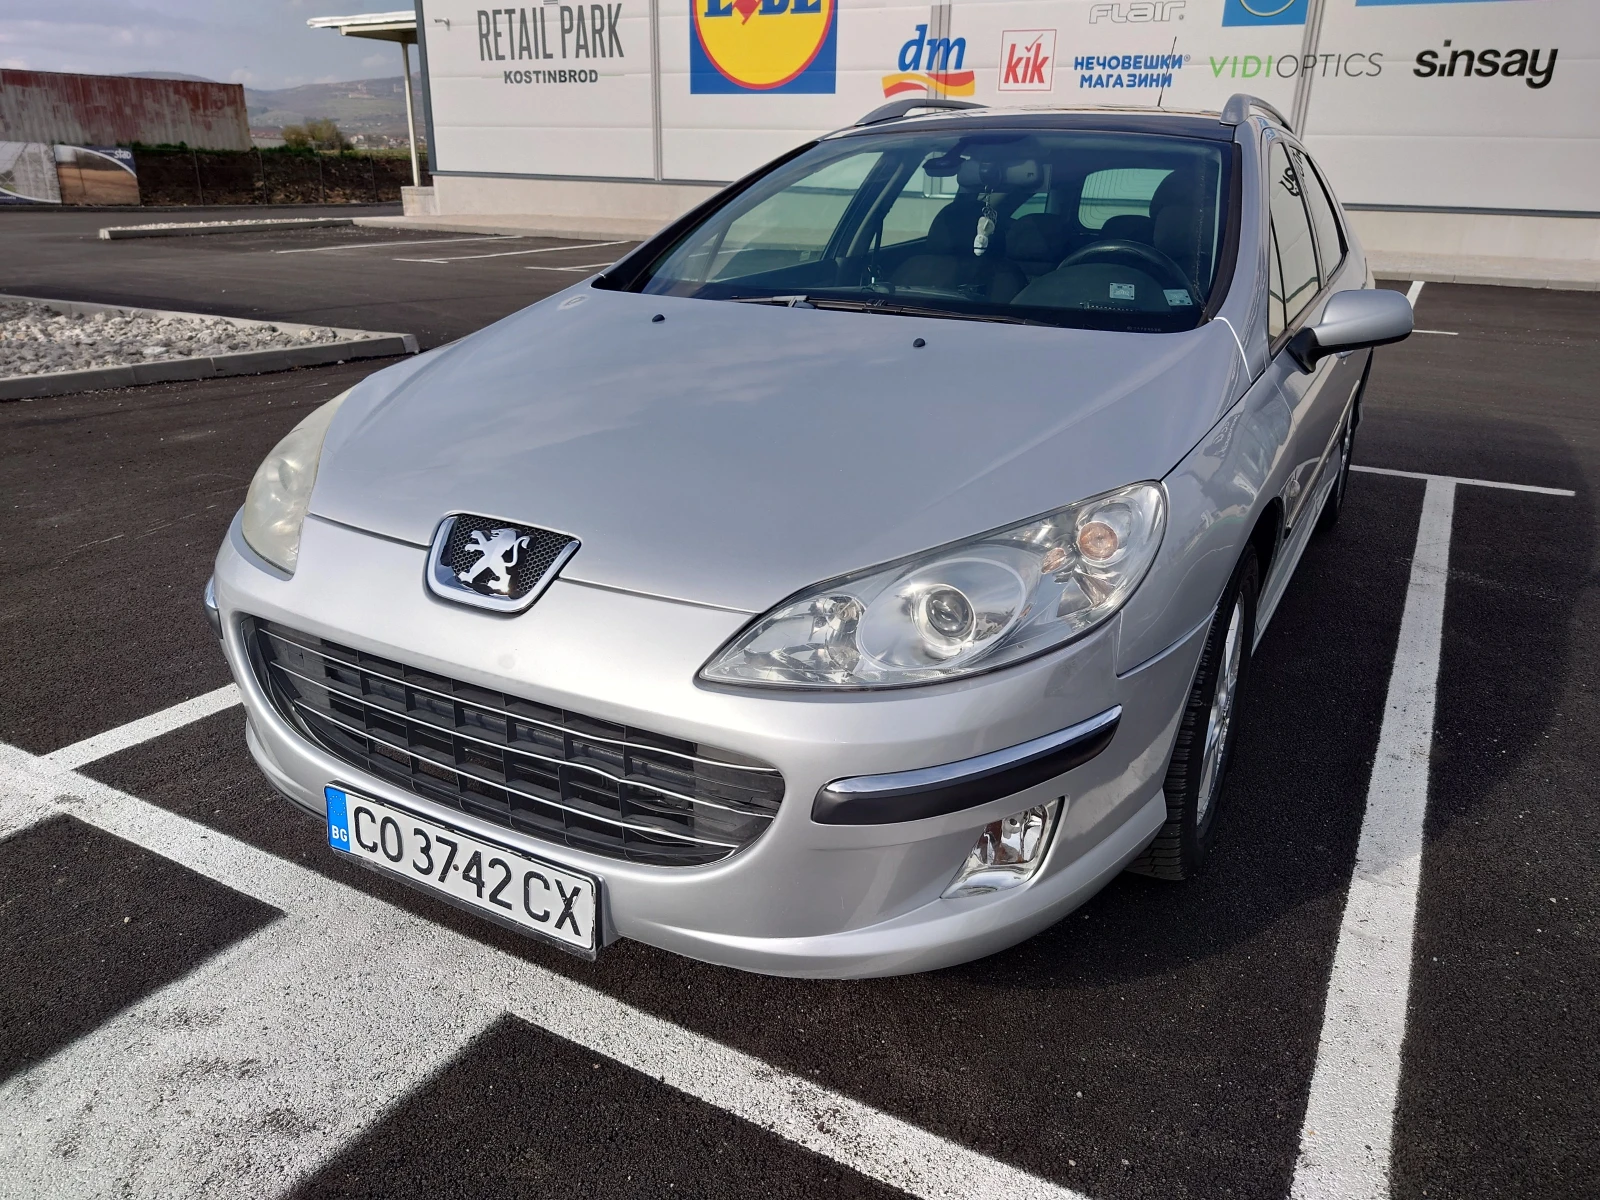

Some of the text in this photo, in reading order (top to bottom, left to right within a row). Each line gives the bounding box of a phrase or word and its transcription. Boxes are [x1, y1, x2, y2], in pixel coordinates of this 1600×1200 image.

[477, 3, 624, 61] RETAIL PARK
[898, 24, 966, 71] dm
[503, 69, 598, 84] KOSTINBROD
[1004, 36, 1049, 83] kik
[1074, 54, 1183, 70] НЕЧОВЕШКИ
[1209, 53, 1383, 78] VIDIOPTICS
[1413, 40, 1558, 89] sinsay
[1080, 73, 1172, 88] МАГАЗИНИ
[331, 824, 348, 843] BG
[353, 805, 582, 937] CO 3742 CX
